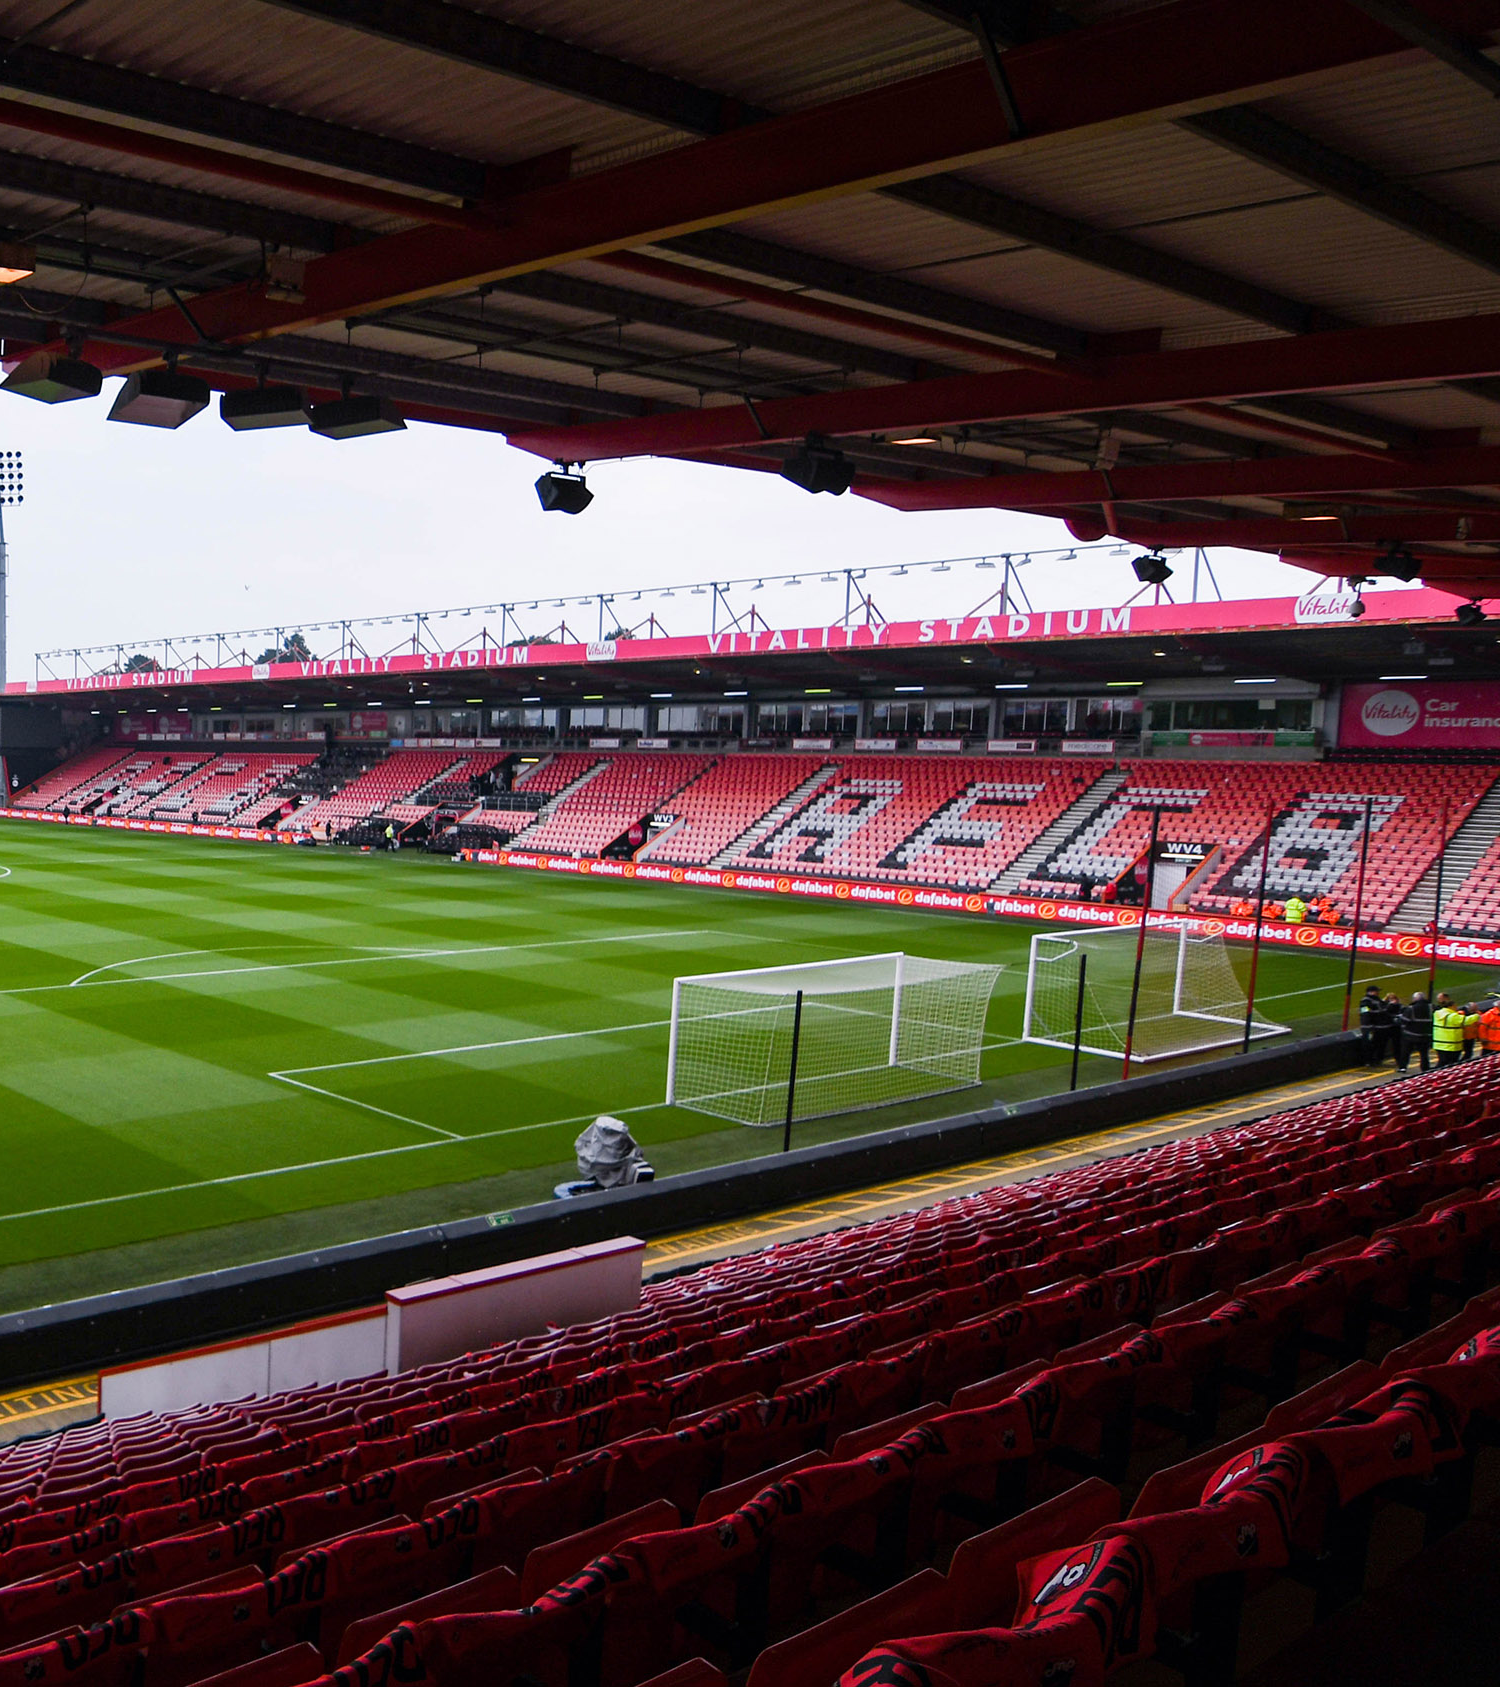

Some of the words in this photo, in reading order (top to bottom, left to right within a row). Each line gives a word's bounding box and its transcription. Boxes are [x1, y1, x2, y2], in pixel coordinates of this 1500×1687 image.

[1298, 595, 1353, 619] Vitalit
[707, 623, 888, 654] VITALITY
[918, 608, 1131, 643] STADIUM
[300, 656, 392, 677] VITALITY
[423, 646, 528, 670] STADIUM
[66, 674, 122, 690] VITALITY
[132, 669, 193, 686] STADIUM
[1364, 700, 1418, 725] Vitality
[1425, 699, 1459, 712] Car
[653, 814, 674, 823] WV3
[1167, 843, 1202, 854] WV4
[508, 853, 536, 866] dafabet
[548, 857, 578, 871] dafabet
[591, 861, 623, 875] dafabet
[636, 865, 670, 879] dafabet
[684, 870, 721, 884] dafabet
[736, 875, 775, 890] dafabet
[791, 880, 833, 896] dafabet
[851, 885, 895, 901] dafabet
[915, 891, 963, 908] dafabet
[984, 899, 1036, 914] afabet
[1058, 905, 1114, 923] dafabet
